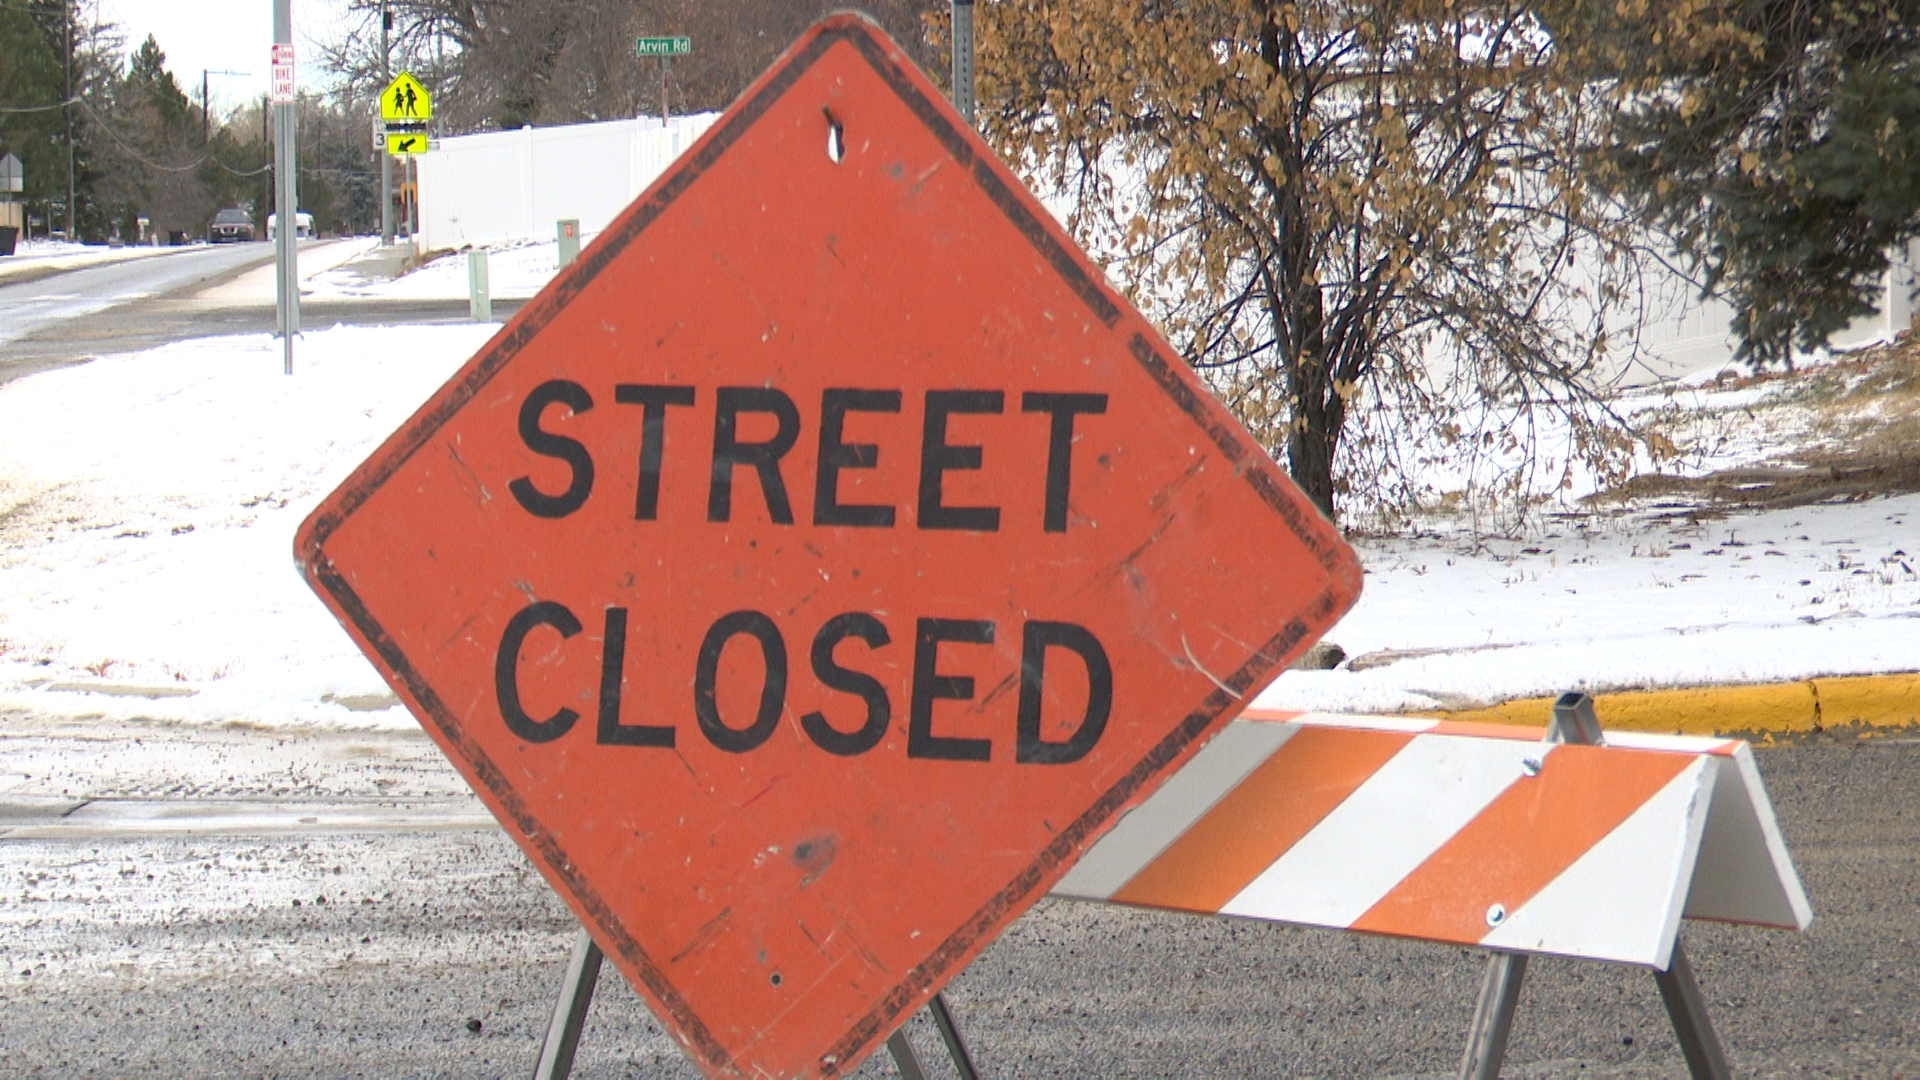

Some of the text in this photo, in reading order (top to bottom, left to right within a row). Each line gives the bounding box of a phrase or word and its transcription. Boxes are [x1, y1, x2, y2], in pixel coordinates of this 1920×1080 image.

[639, 39, 688, 53] Arvin Rd
[275, 68, 291, 80] BIKE
[275, 83, 292, 94] LANE
[375, 133, 385, 146] 3
[508, 379, 1109, 534] STREET
[495, 601, 1113, 765] CLOSED
